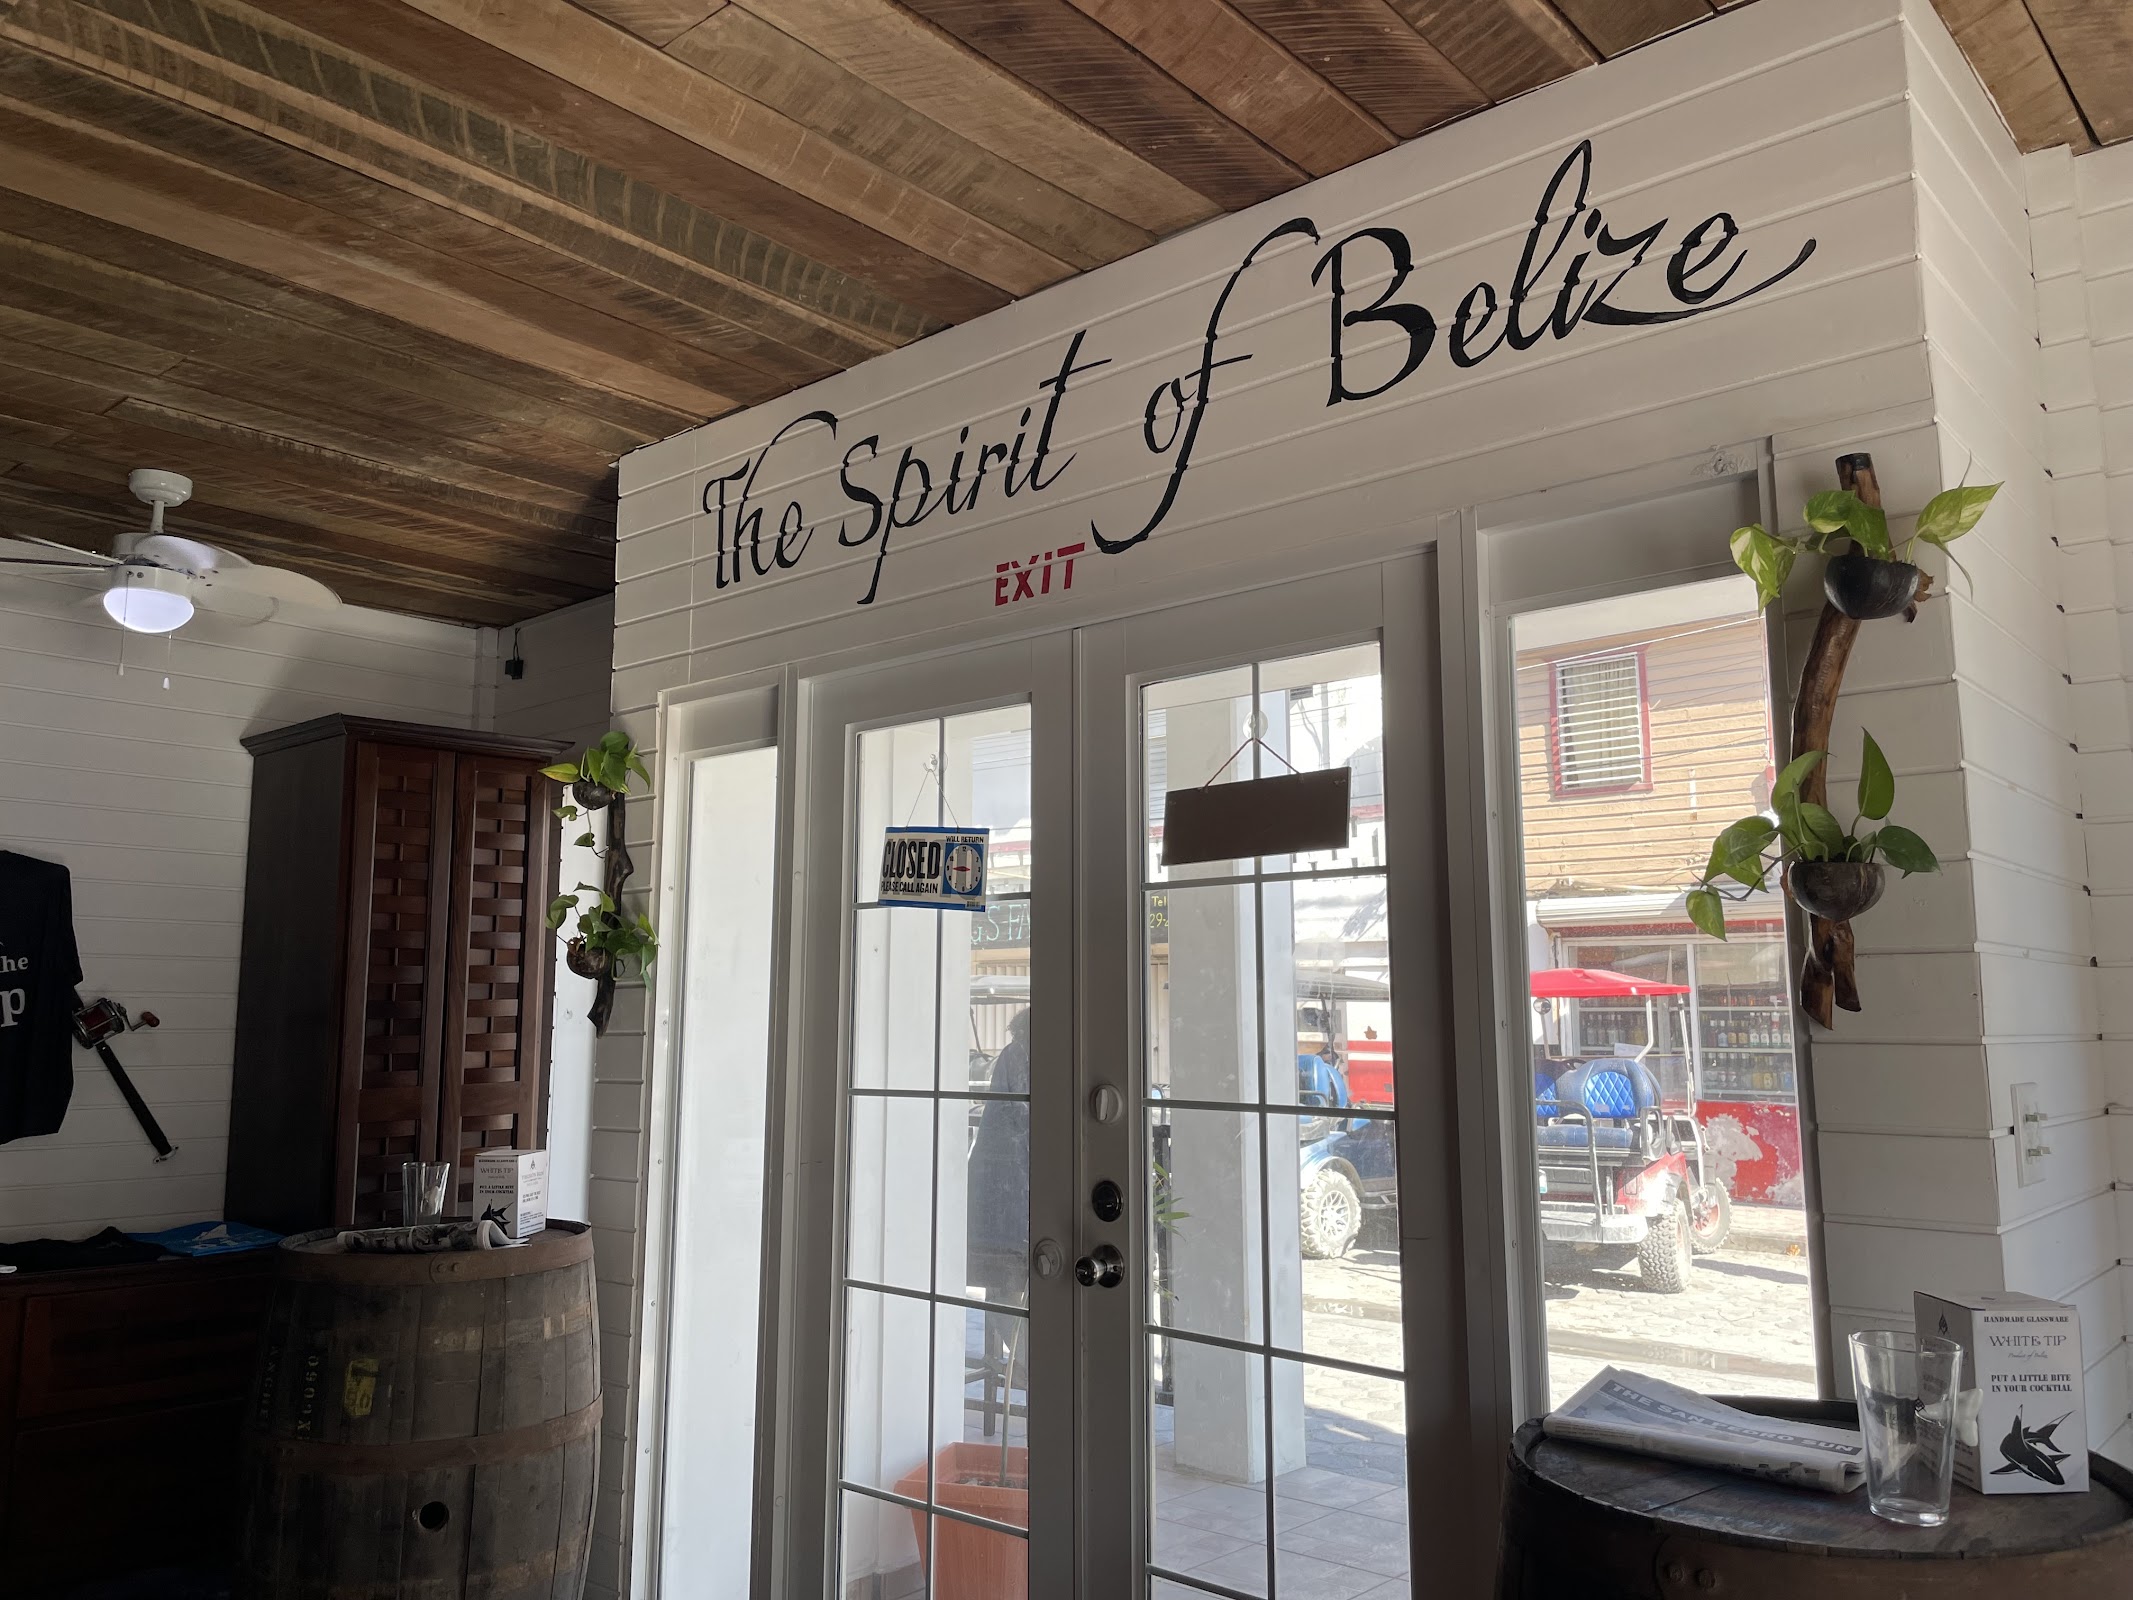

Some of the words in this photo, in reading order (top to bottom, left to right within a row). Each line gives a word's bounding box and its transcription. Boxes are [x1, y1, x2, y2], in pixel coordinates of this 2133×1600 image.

[703, 410, 837, 589] The
[838, 327, 1112, 605] Spirit
[1090, 217, 1321, 555] of
[1310, 138, 1818, 408] Belize
[994, 542, 1086, 607] EXIT
[882, 841, 942, 879] CLOSED
[881, 881, 900, 892] PLEASE
[900, 882, 915, 893] CALL
[915, 883, 938, 894] AGAIN
[0, 955, 29, 973] he
[1988, 1335, 2042, 1347] WHITE
[2042, 1335, 2068, 1347] TIP
[1991, 1374, 2009, 1382] PUT
[2011, 1374, 2017, 1382] A
[2019, 1374, 2048, 1382] LITTLE
[2051, 1374, 2072, 1382] BITE
[1991, 1385, 2001, 1393] IN
[2003, 1384, 2027, 1392] YOUR
[2029, 1384, 2073, 1392] COCKTIAL
[1611, 1382, 1653, 1405] THE
[1656, 1403, 1707, 1426] SAN
[1708, 1420, 1795, 1442] PEDRO
[1799, 1437, 1854, 1453] SUN
